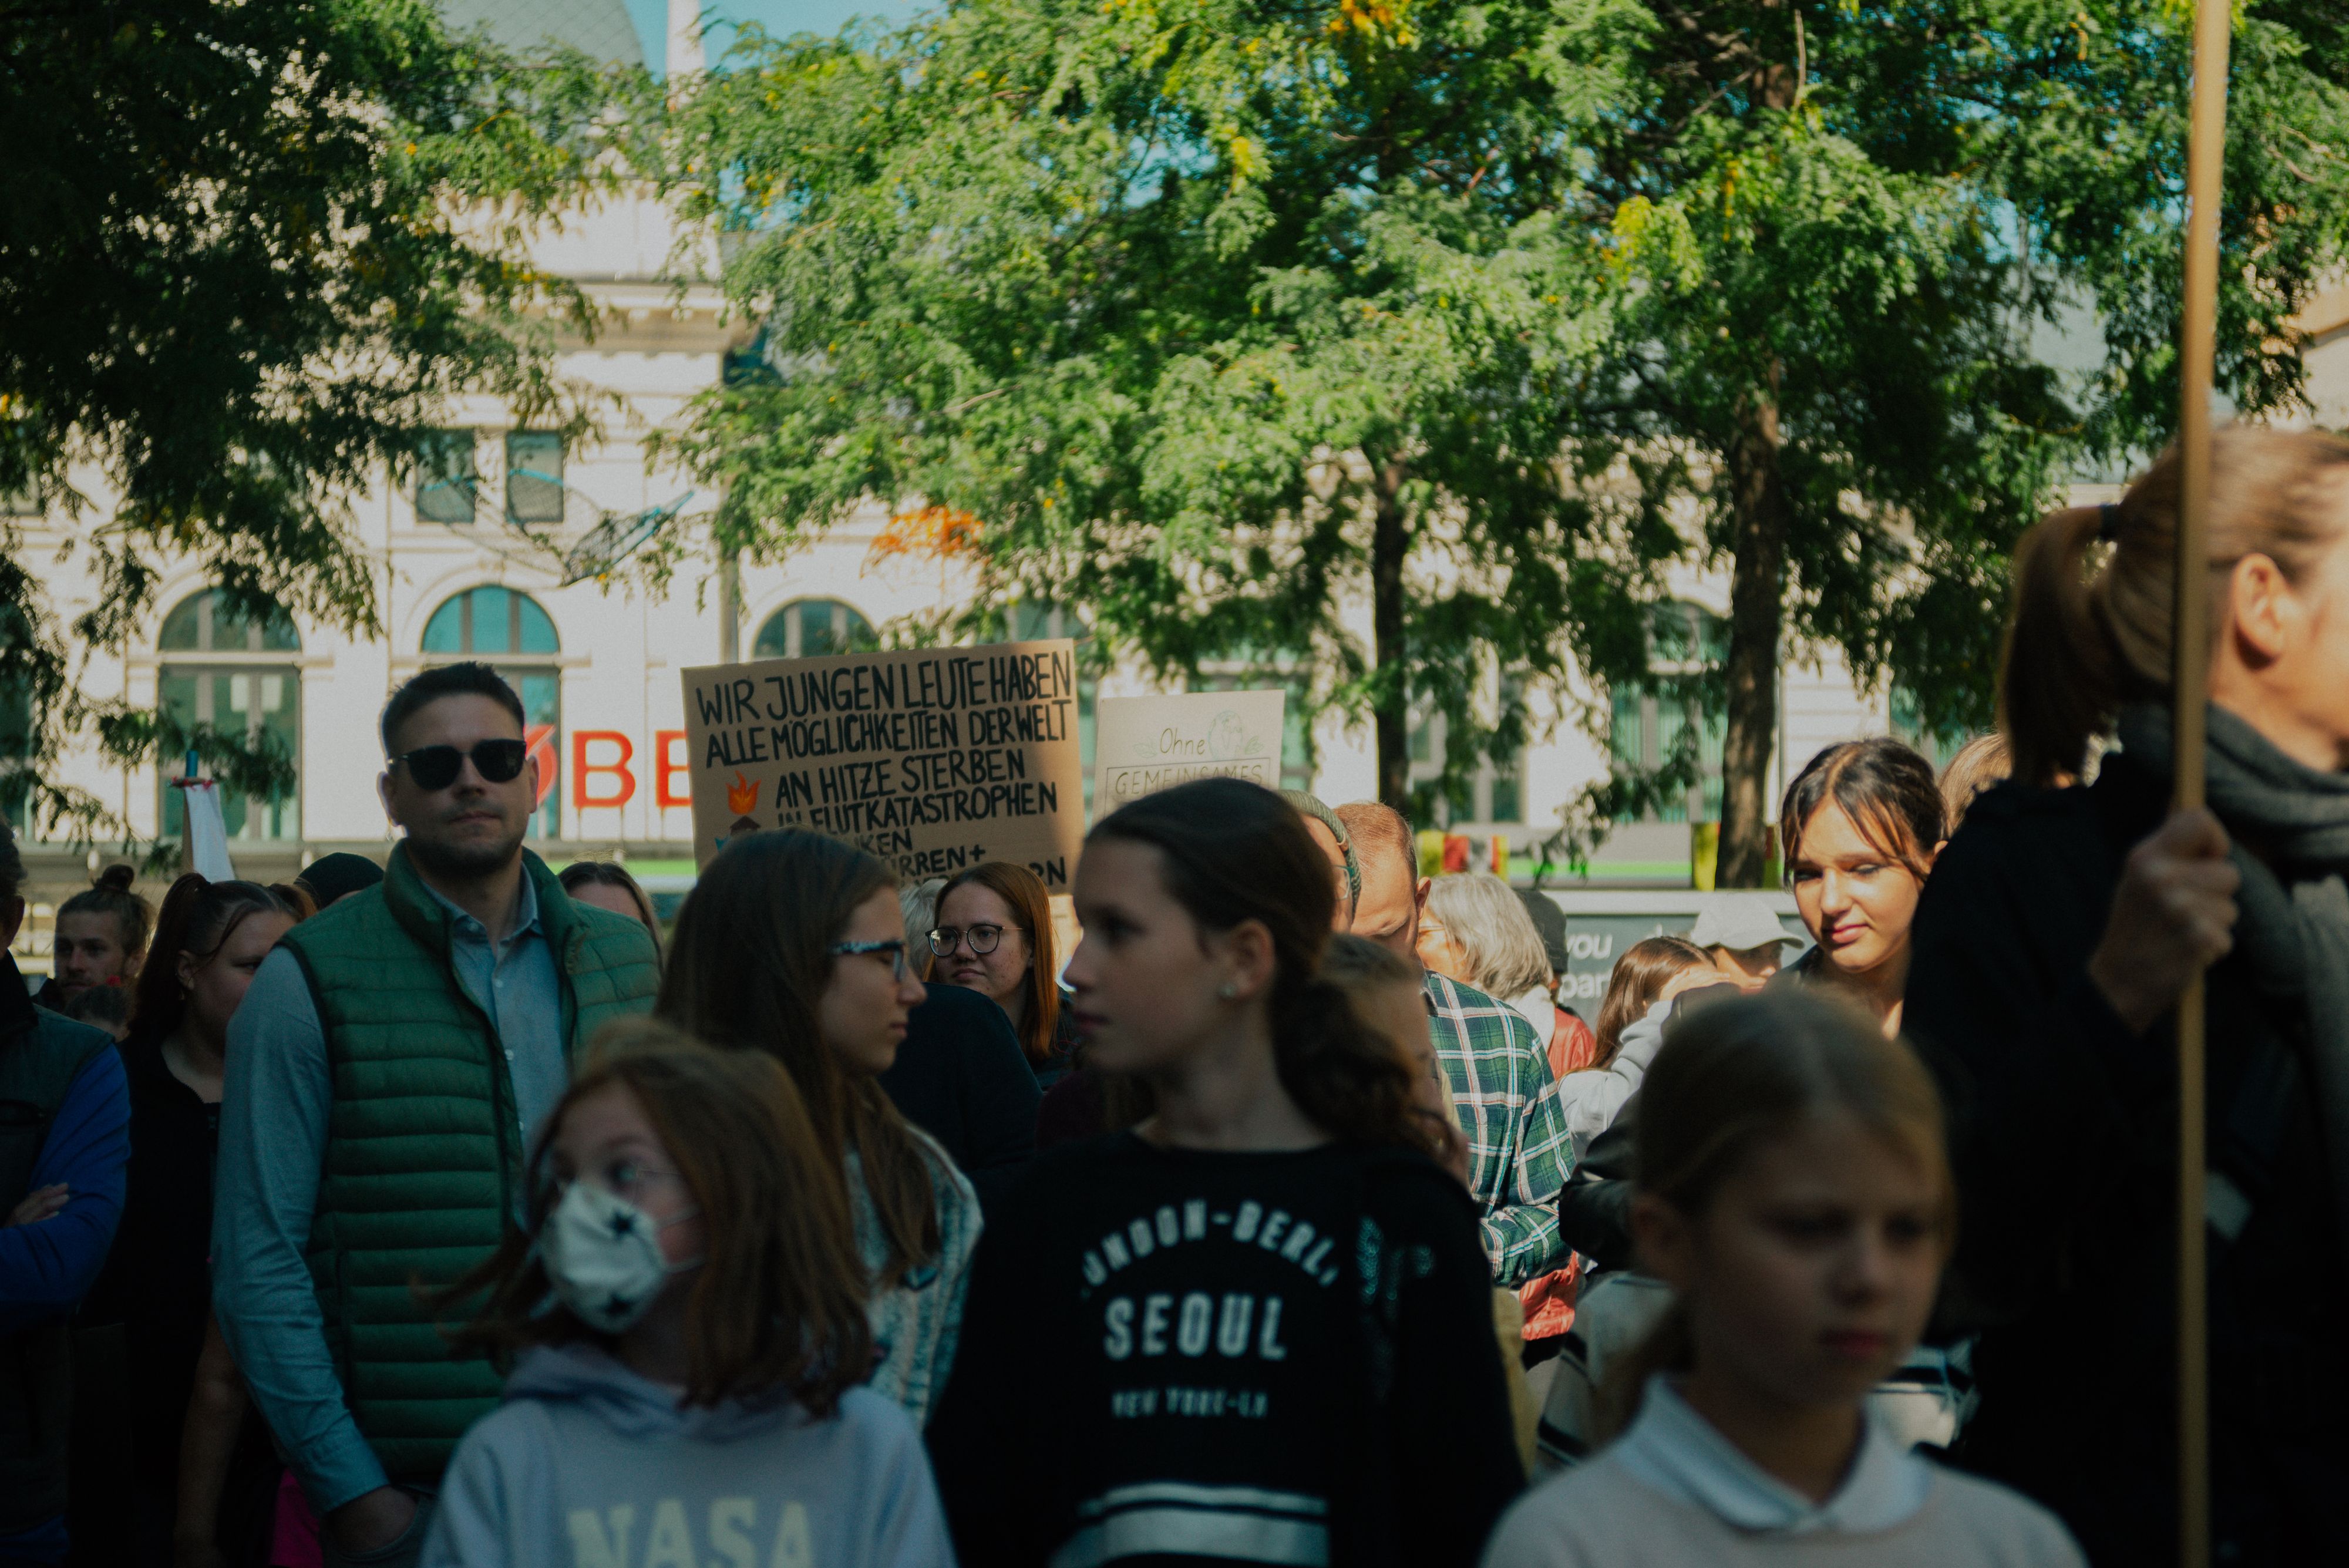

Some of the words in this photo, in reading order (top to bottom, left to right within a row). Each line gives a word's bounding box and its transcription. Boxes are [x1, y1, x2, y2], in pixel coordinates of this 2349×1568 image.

[696, 678, 760, 725] WIR
[765, 664, 893, 721] JUNGEN
[900, 657, 987, 711] LEUTE
[990, 650, 1071, 704] HABEN
[706, 726, 768, 768] ALLE
[770, 711, 958, 761] MÖGLICHKEITEN
[968, 706, 1016, 746] DER
[1014, 699, 1072, 743] WELT
[1160, 728, 1206, 755] Ohne
[776, 770, 813, 809] AN
[819, 759, 896, 804] HITZE
[901, 748, 1025, 793] STERBEN
[810, 782, 1057, 835] FLUTKATASTROPHEN
[1103, 1291, 1288, 1361] SEOUL
[567, 1497, 814, 1568] NASA
